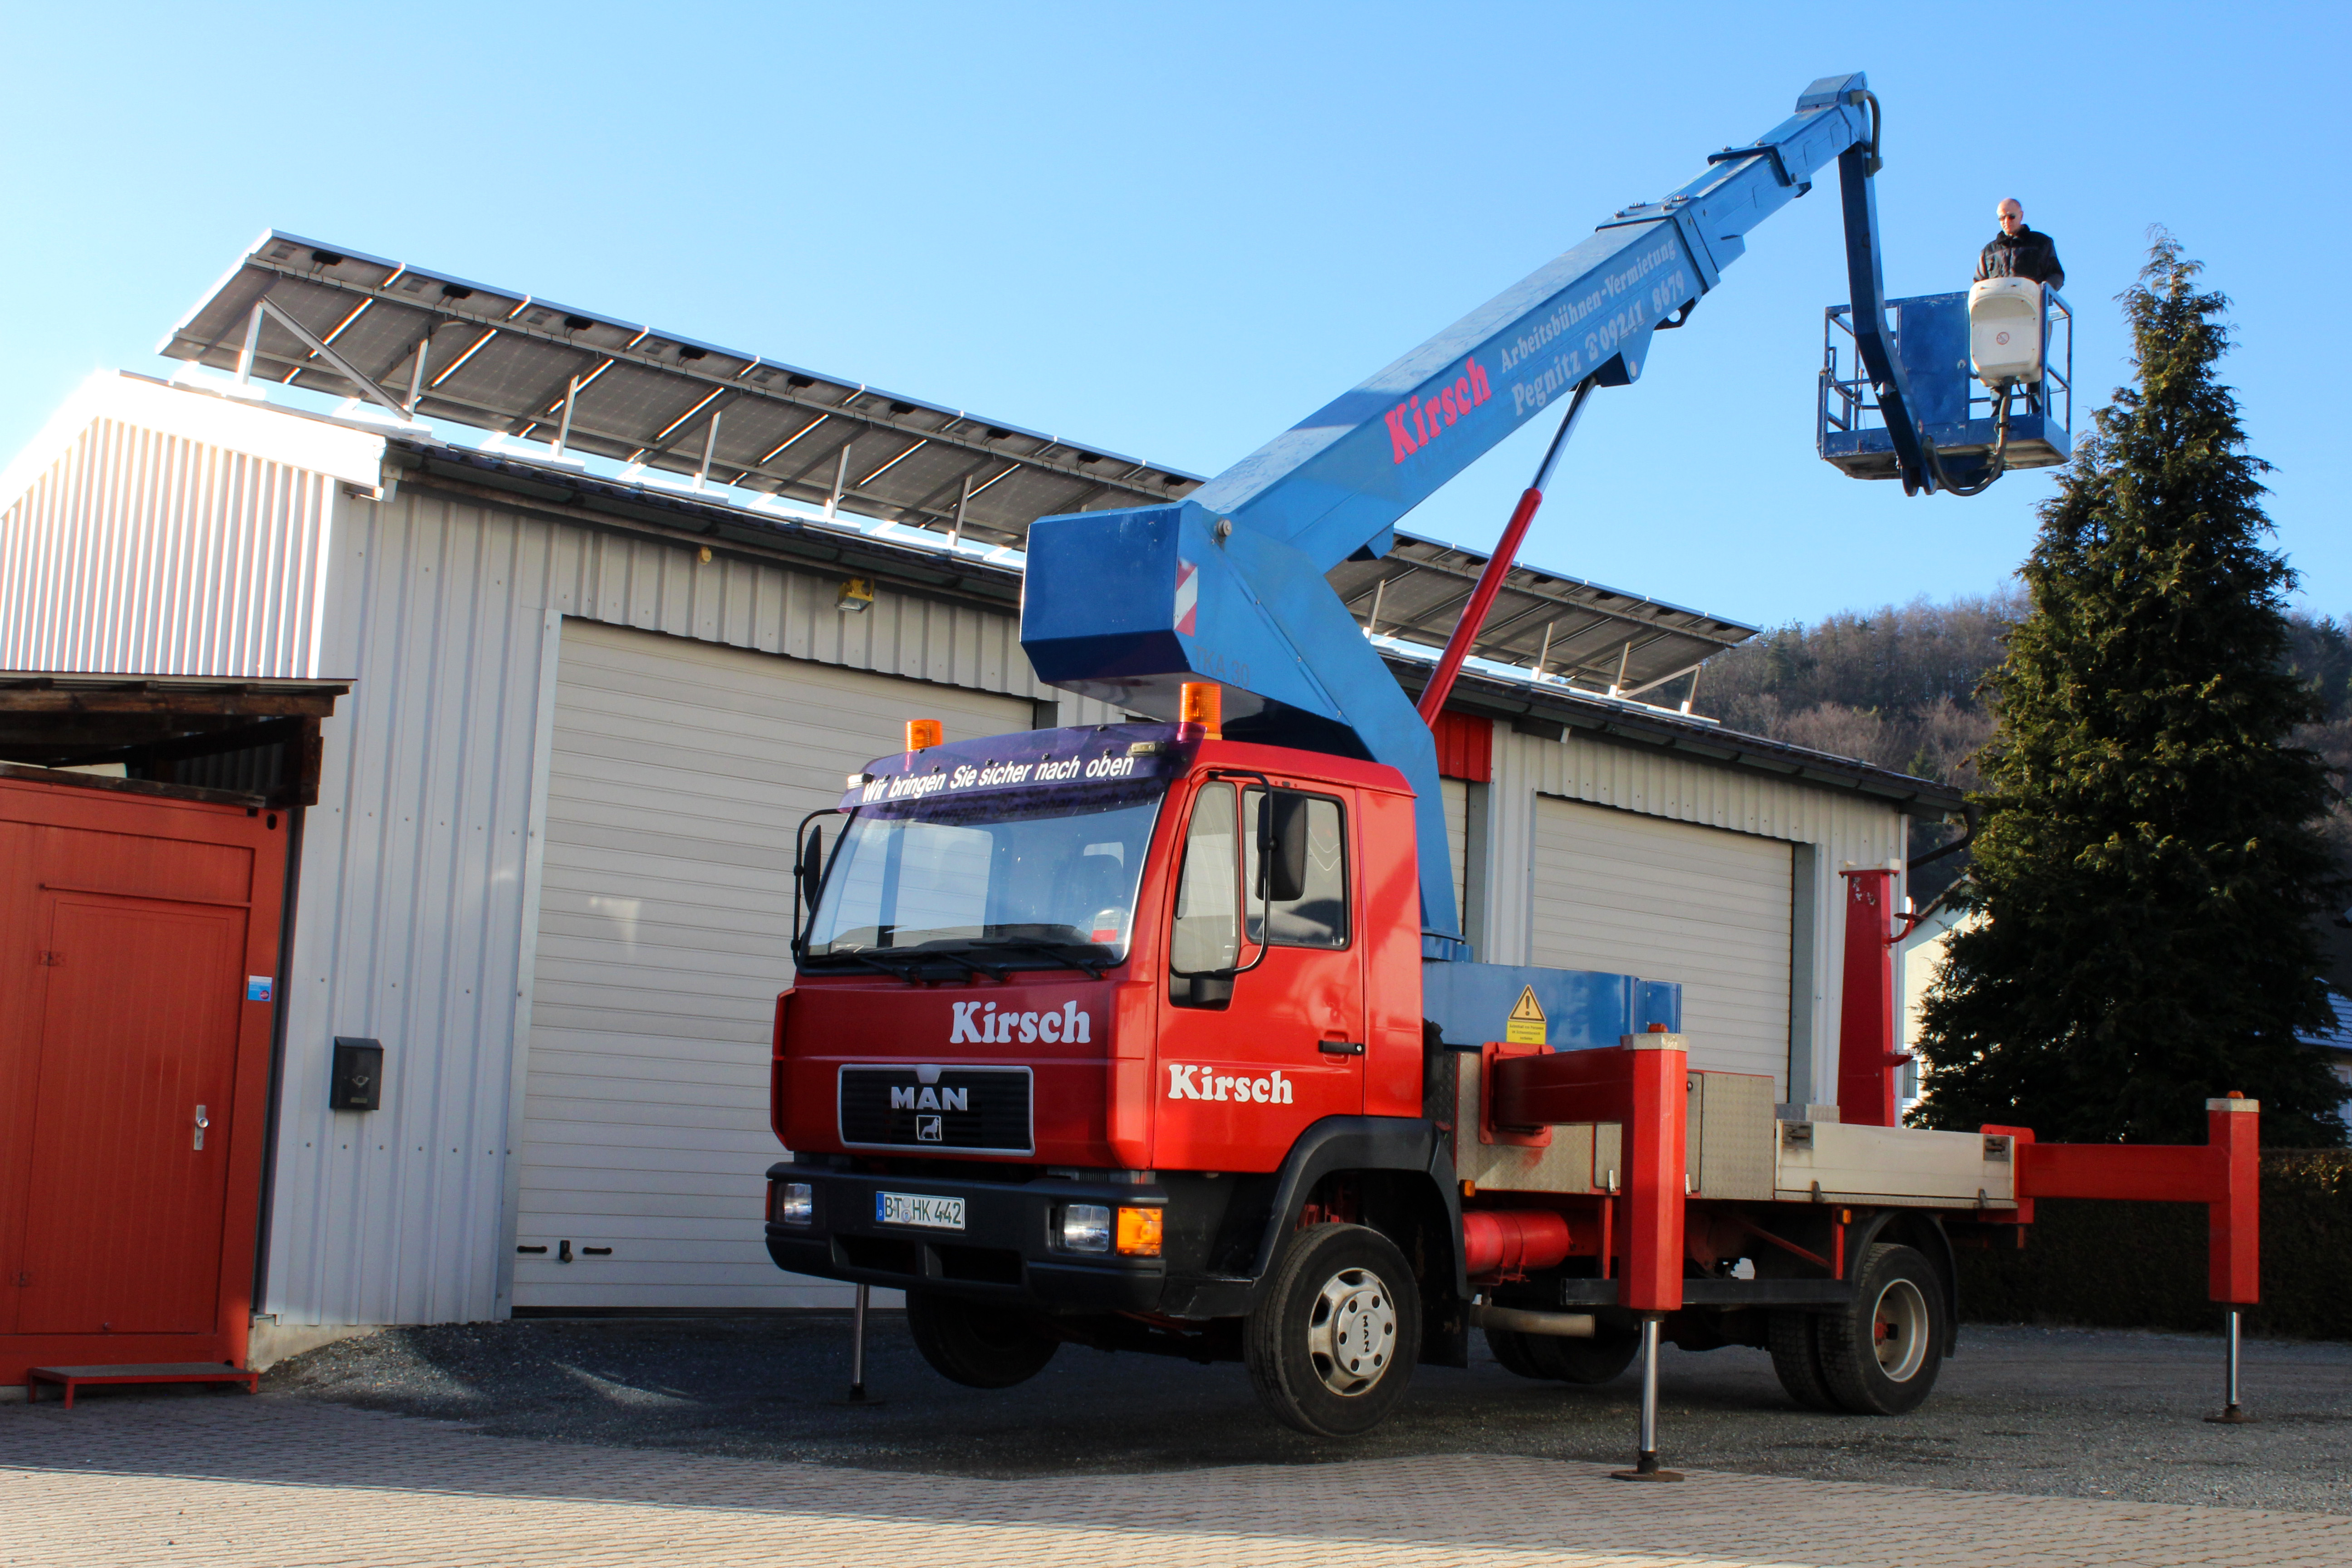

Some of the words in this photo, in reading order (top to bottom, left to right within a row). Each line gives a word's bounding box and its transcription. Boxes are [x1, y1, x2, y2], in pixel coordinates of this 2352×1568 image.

[1501, 239, 1676, 373] Arbeitsbühnen-Vermietung
[1512, 350, 1581, 416] Pegnitz
[1599, 299, 1645, 351] 09241
[1652, 269, 1684, 313] 8679
[1385, 356, 1492, 465] Kirsch
[1194, 645, 1227, 680] TKA
[1232, 660, 1250, 687] 30
[862, 777, 888, 803] Wir
[888, 773, 947, 799] bringen
[950, 764, 978, 789] Sie
[978, 760, 1033, 786] sicher
[1034, 755, 1081, 781] nach
[1085, 755, 1134, 778] oben
[950, 1000, 1091, 1044] Kirsch
[891, 1086, 968, 1111] MAN
[1167, 1064, 1294, 1104] Kirsch
[885, 1196, 902, 1219] BT
[913, 1199, 931, 1221] HK
[935, 1201, 961, 1225] 442
